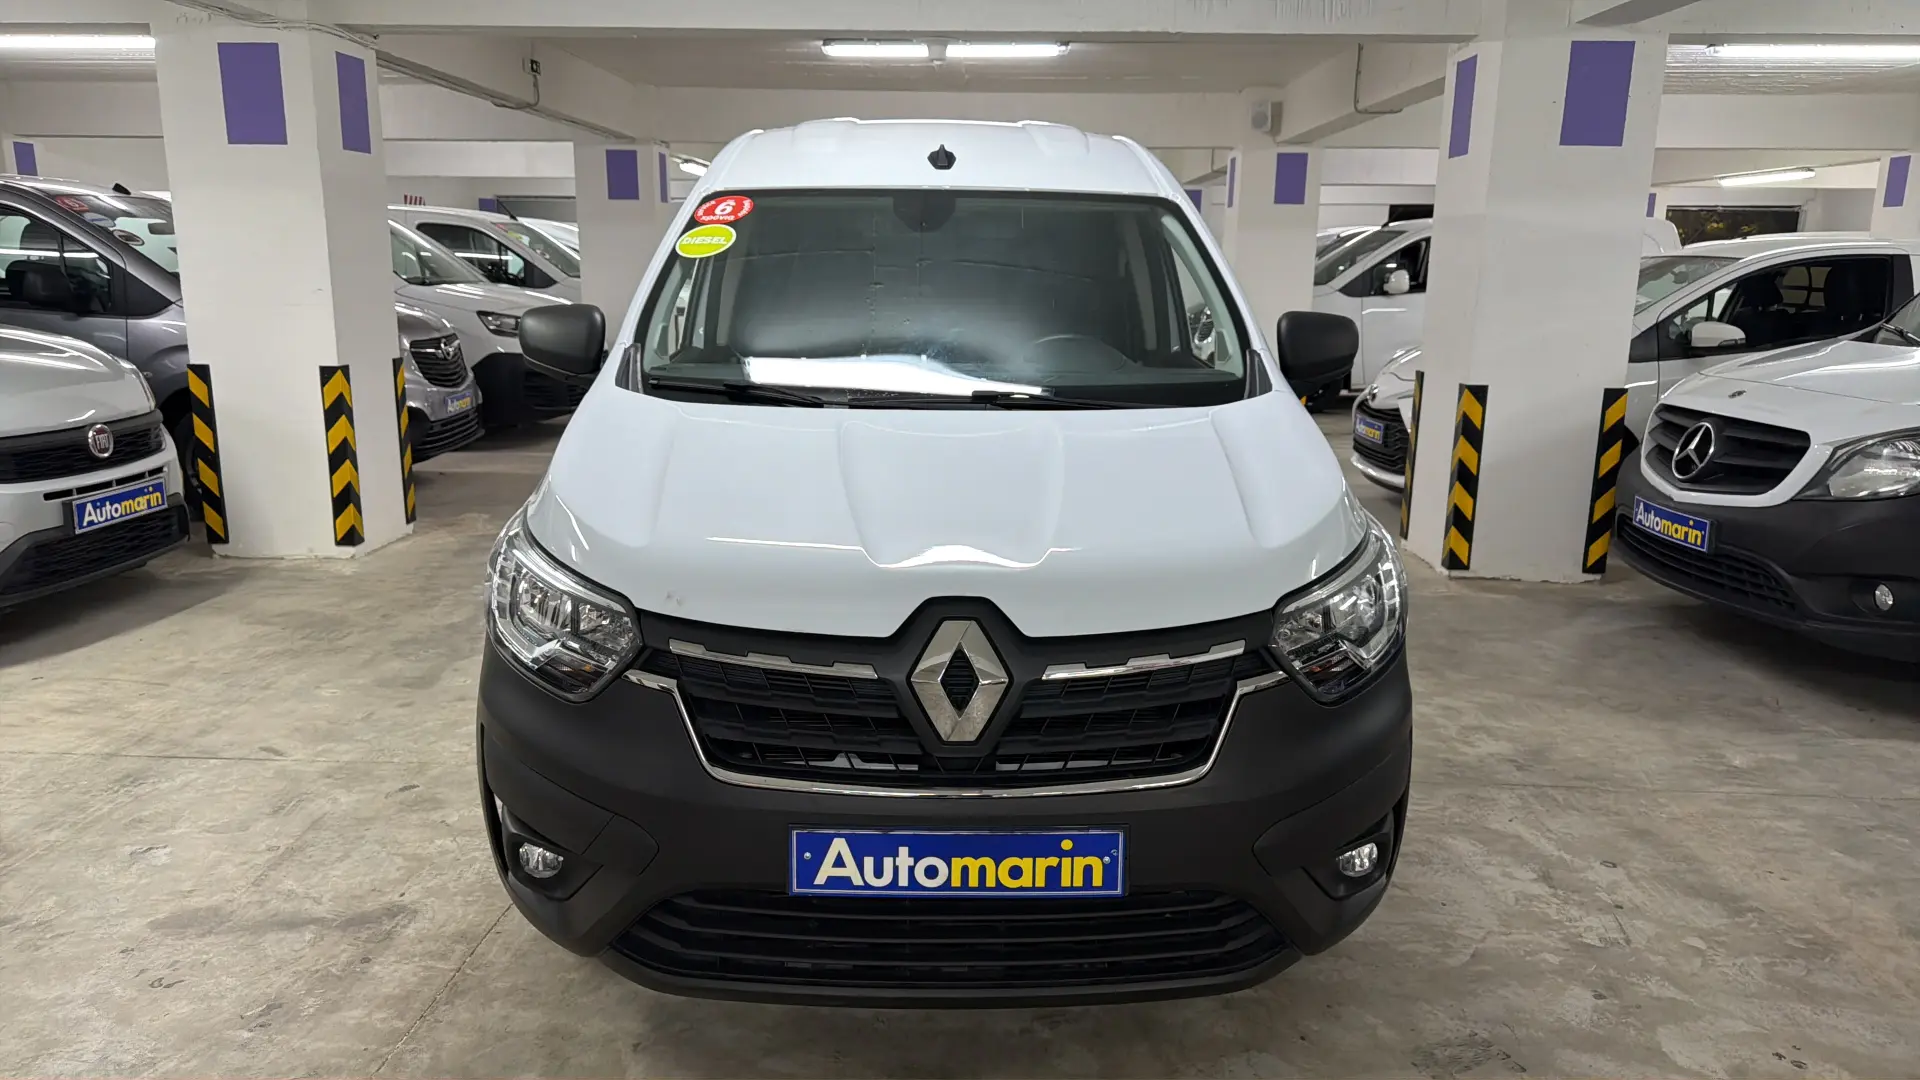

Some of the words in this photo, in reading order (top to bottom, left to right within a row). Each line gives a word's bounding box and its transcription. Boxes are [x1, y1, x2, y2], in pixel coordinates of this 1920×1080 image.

[714, 200, 736, 215] 6
[680, 236, 728, 245] DIESEL
[82, 486, 163, 527] Automarin
[1636, 501, 1703, 546] Automarin
[813, 837, 1103, 889] Automarin
